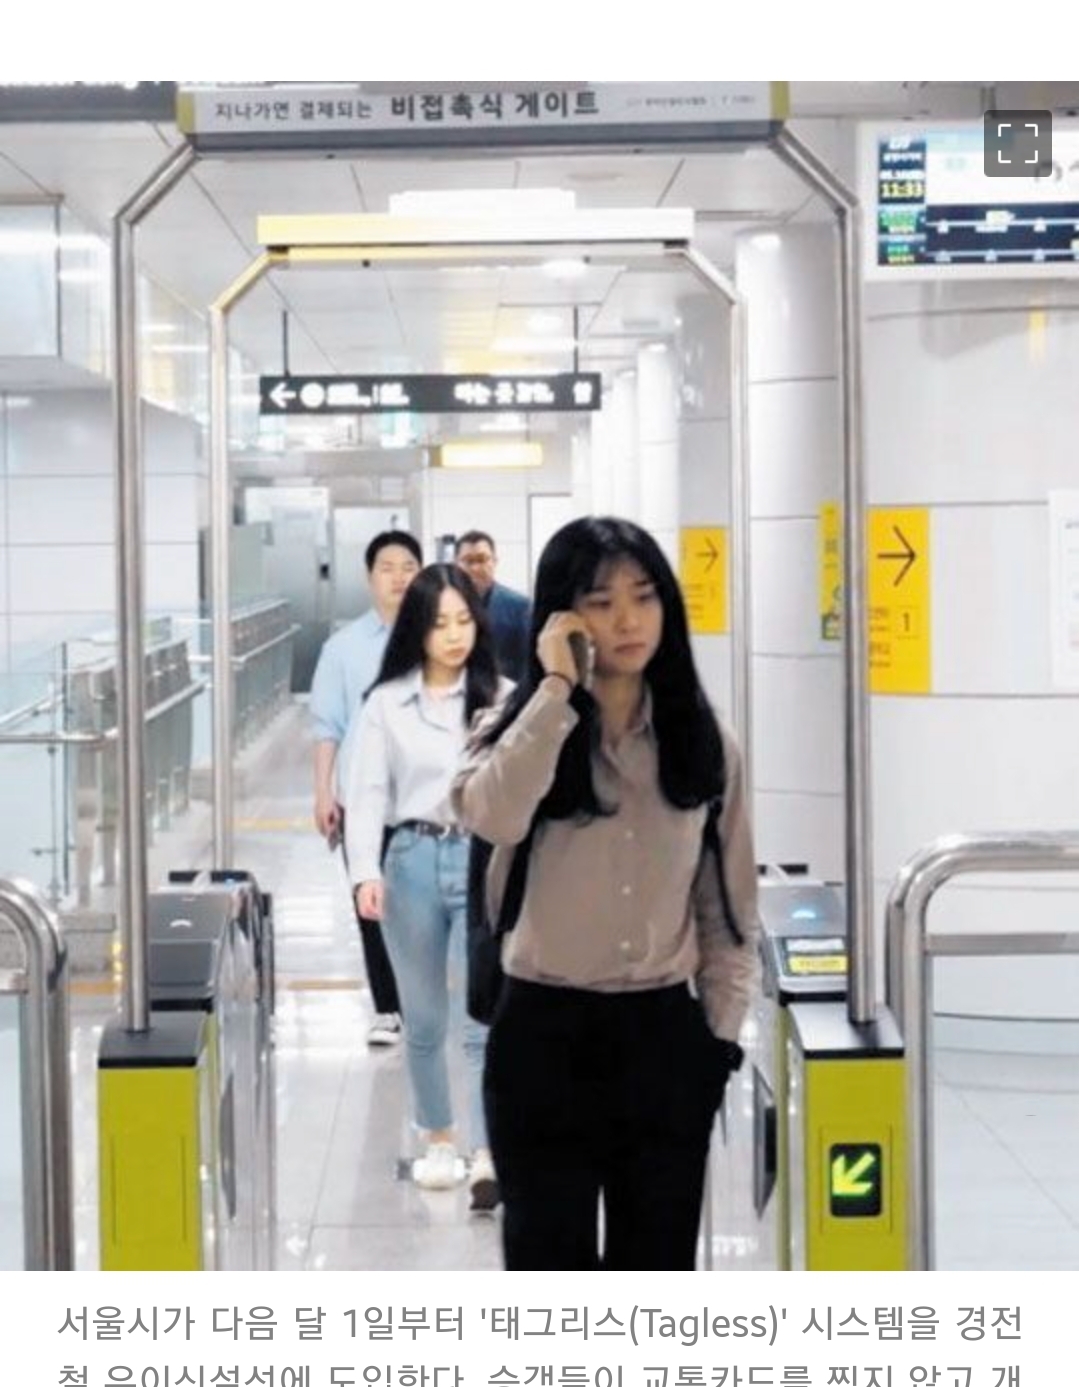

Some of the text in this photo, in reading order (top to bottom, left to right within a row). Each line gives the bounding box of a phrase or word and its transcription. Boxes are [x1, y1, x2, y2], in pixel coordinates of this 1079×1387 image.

[299, 98, 373, 121] 결제되는
[390, 91, 504, 122] 비접촉식
[514, 90, 600, 119] 게이트
[57, 1305, 196, 1341] 서울시가
[212, 1305, 278, 1341] 다음
[295, 1306, 327, 1341] 달
[343, 1305, 463, 1341] 1일부터
[801, 1305, 940, 1341] 시스템을
[956, 1305, 1022, 1342] 경전
